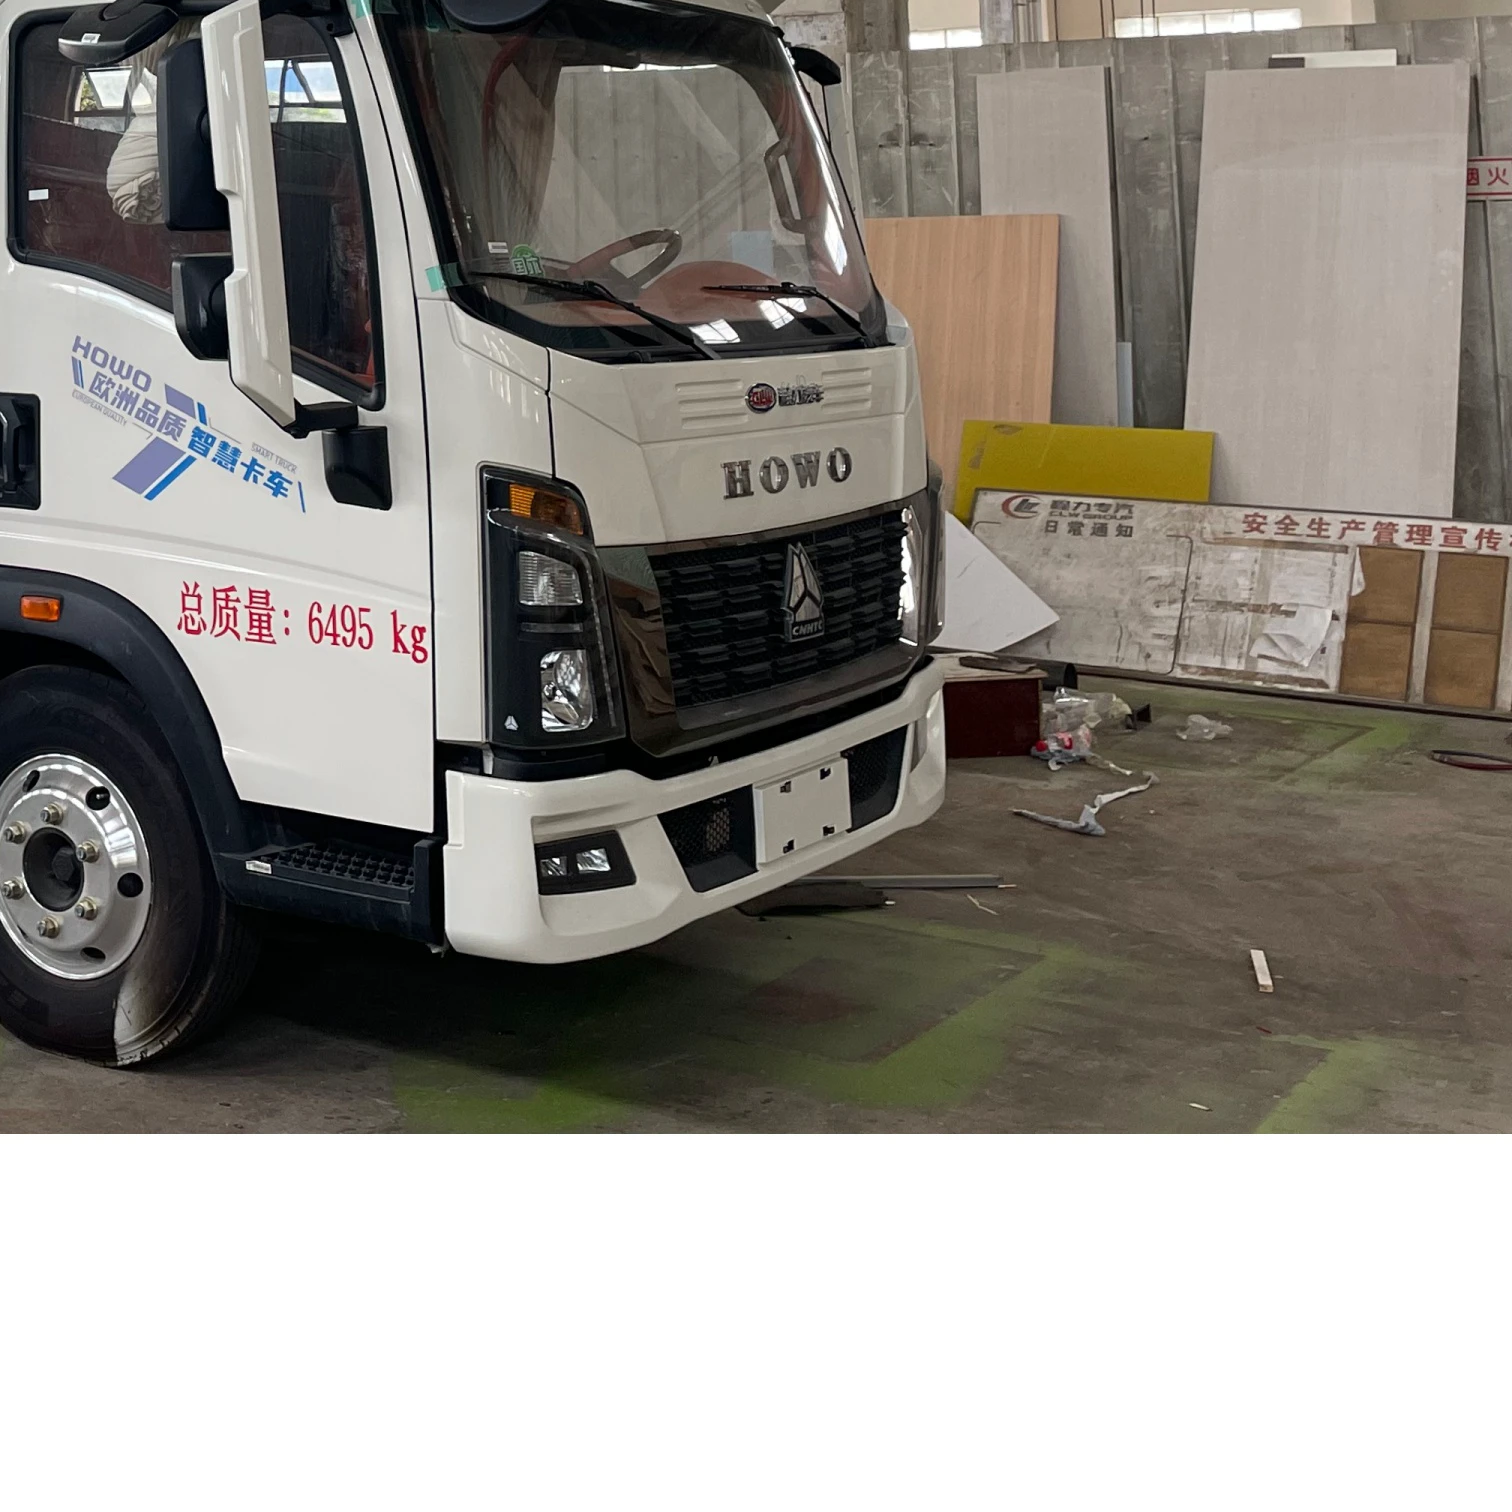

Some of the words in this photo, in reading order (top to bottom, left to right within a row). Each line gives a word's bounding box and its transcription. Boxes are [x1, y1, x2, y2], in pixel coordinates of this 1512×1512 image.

[72, 335, 152, 393] HOWO
[88, 371, 187, 443] 欧洲品质
[102, 406, 128, 426] QUALITY
[188, 426, 293, 498] 智慧卡车
[251, 442, 275, 461] SMART
[275, 455, 298, 474] TRUCK
[720, 447, 852, 500] HOWO
[1044, 520, 1134, 538] 日常通知
[1242, 512, 1512, 552] 安全生产管理宣传
[308, 601, 374, 650] 6495
[390, 609, 429, 664] kg
[792, 620, 823, 636] CNHTC
